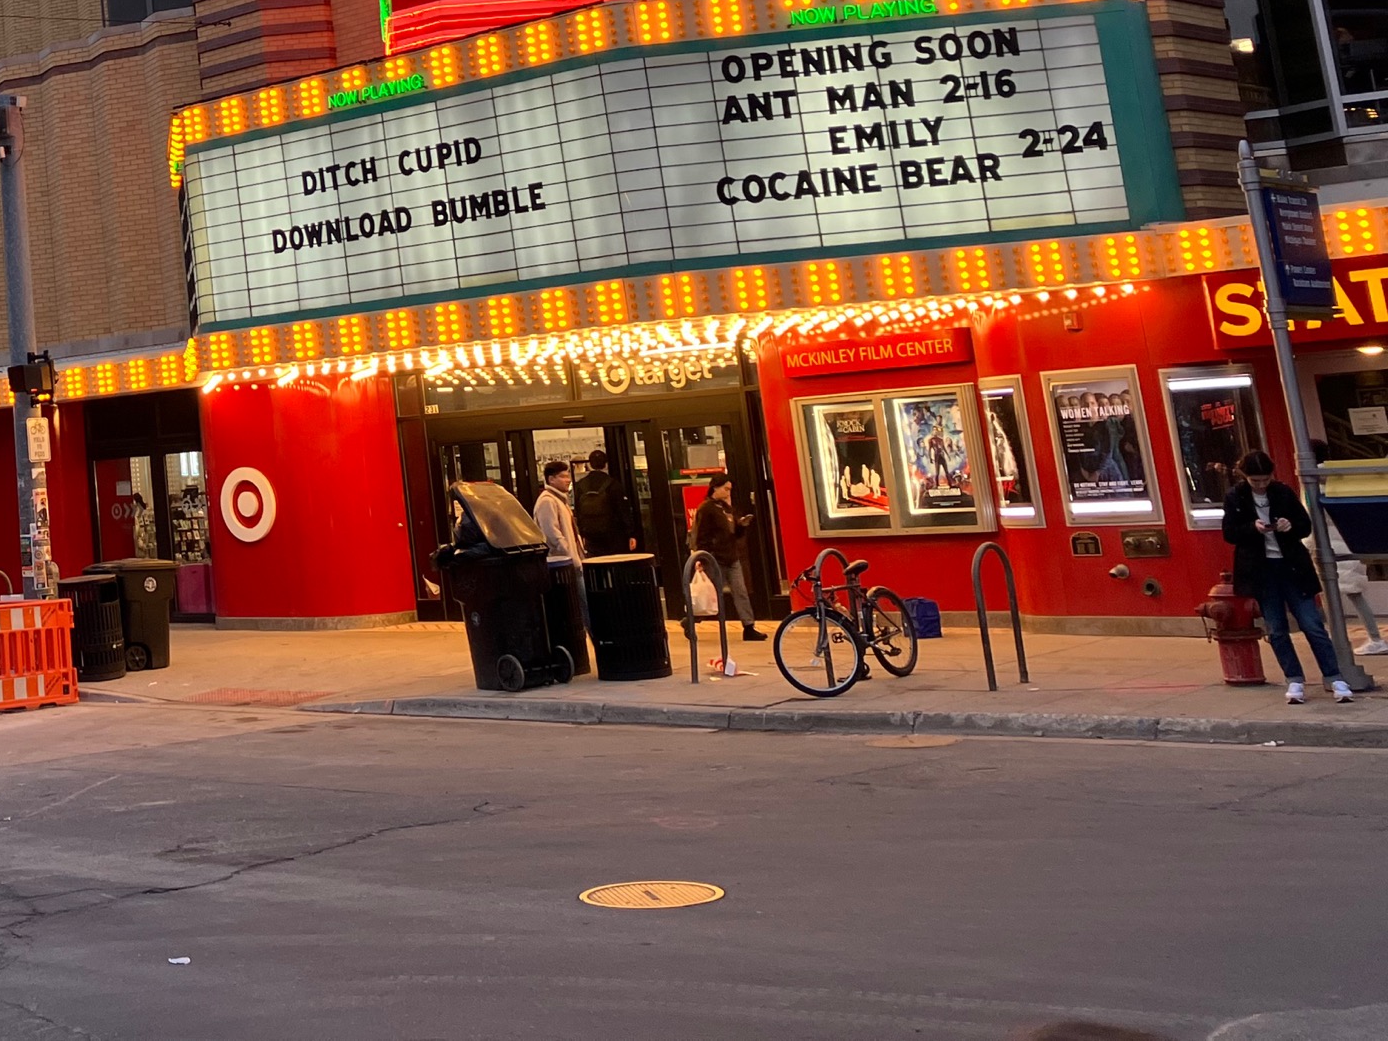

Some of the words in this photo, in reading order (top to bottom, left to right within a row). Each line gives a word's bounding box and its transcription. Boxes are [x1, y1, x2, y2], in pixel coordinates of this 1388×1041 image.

[791, 5, 836, 26] NOW
[722, 40, 893, 84] OPENING
[914, 27, 1020, 65] SOON
[328, 89, 359, 109] NOW
[362, 74, 424, 100] PLAYING
[722, 89, 797, 125] ANT
[826, 78, 916, 115] MAN
[939, 69, 1017, 104] 2-16
[828, 116, 944, 155] EMILY
[302, 156, 378, 196] DITCH
[398, 137, 482, 176] CUPID
[716, 163, 883, 206] COCAINE
[900, 152, 1003, 190] BEAR
[1018, 121, 1108, 158] 2-24
[272, 206, 412, 254] DOWNLOAD
[432, 182, 546, 227] BUMBLE
[633, 355, 713, 388] target
[786, 348, 856, 368] MCKINLEY
[859, 344, 893, 361] FILM
[896, 338, 953, 357] CENTER
[1061, 406, 1093, 419] WOMEN
[1095, 404, 1130, 417] TALKING
